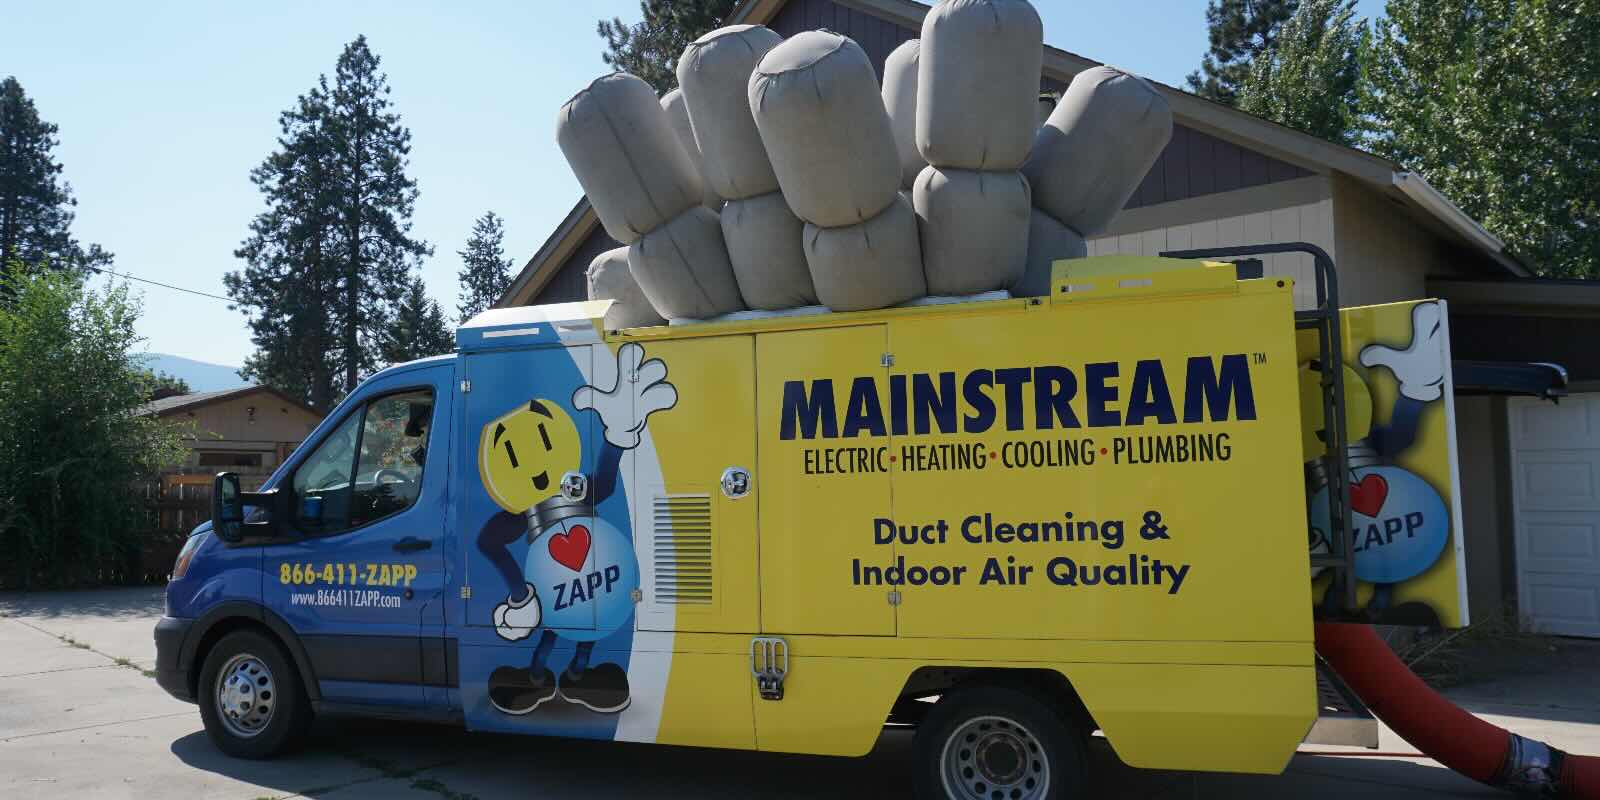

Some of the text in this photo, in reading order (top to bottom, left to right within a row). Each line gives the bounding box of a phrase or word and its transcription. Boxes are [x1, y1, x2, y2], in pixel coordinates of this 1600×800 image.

[780, 354, 1257, 440] MAINSTREAM
[804, 433, 1232, 474] ELECTRIC HEATING COOLING PLUMBING
[873, 510, 1171, 550] Duct Cleaning &
[279, 562, 417, 587] 866-411-ZAPP
[552, 564, 620, 612] ZAPP
[852, 553, 1191, 595] Indoor Air Quality
[291, 589, 401, 608] www.866411ZAPP.com
